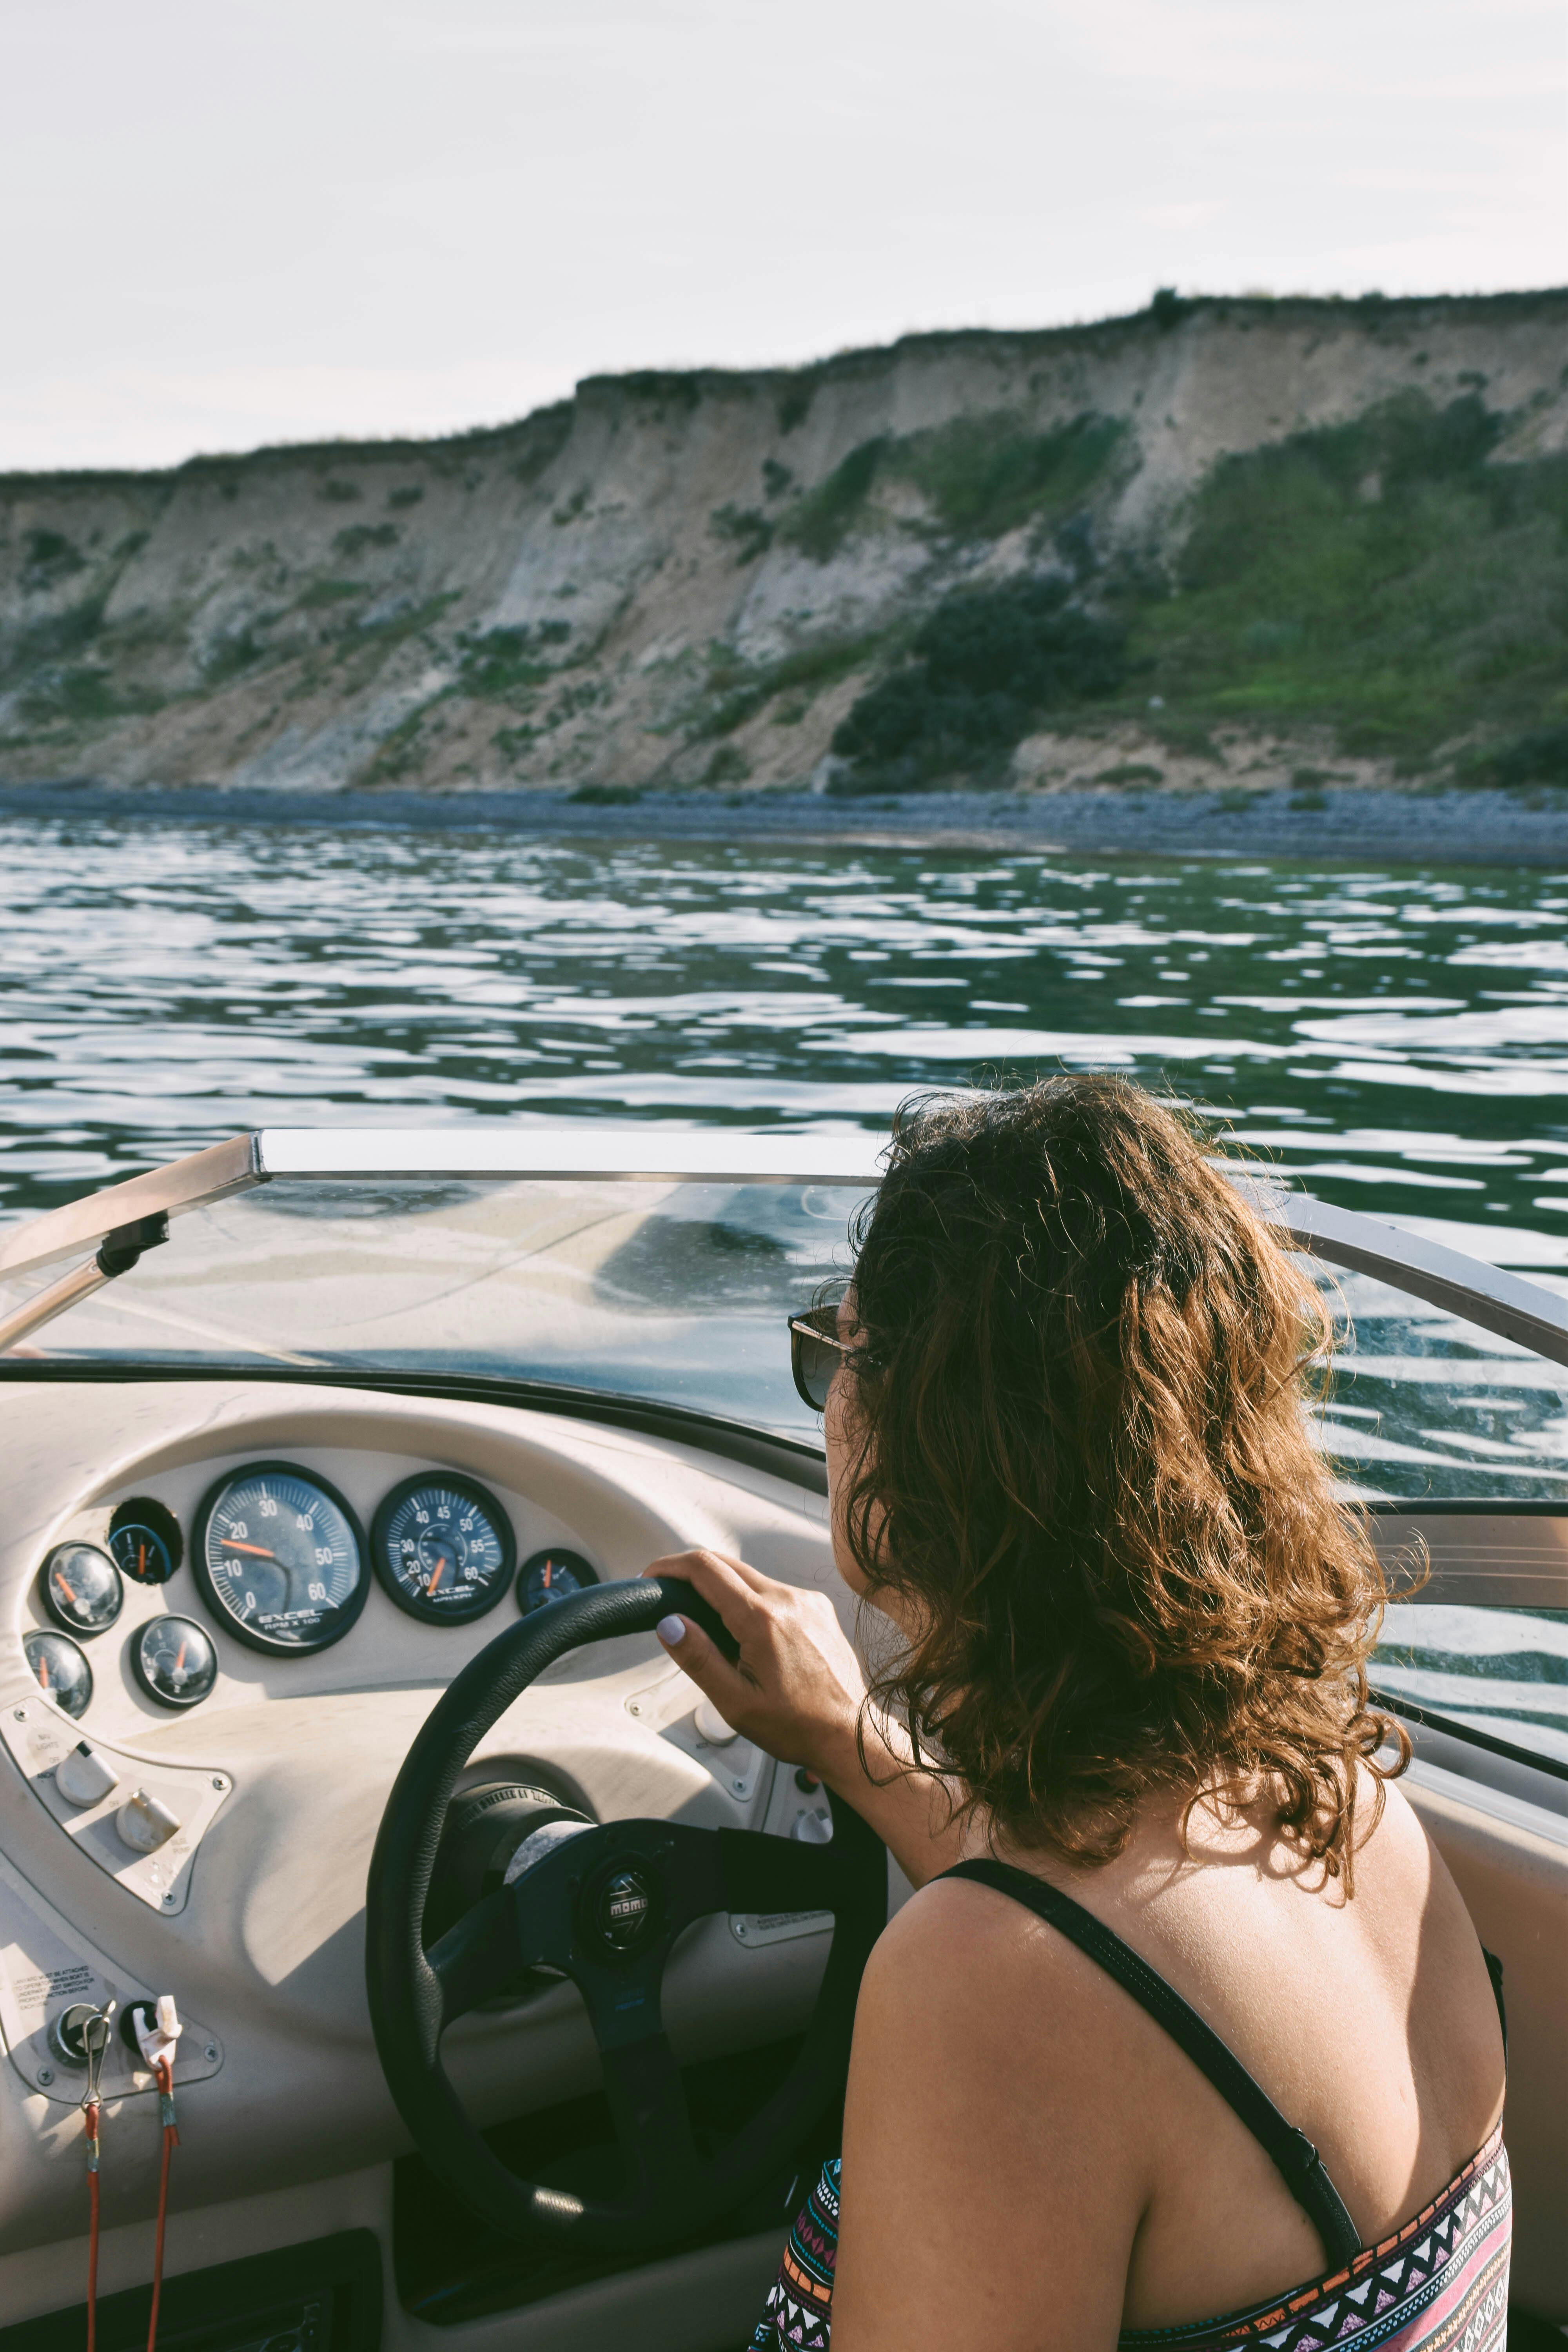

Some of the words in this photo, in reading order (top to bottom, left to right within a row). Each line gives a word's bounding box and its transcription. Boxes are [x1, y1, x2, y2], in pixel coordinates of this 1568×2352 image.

[259, 1500, 277, 1516] 30
[437, 1506, 450, 1519] 45
[296, 1514, 313, 1531] 40
[416, 1510, 429, 1524] 40
[229, 1522, 247, 1539] 20
[459, 1518, 473, 1532] 50
[400, 1539, 414, 1552] 30
[471, 1539, 485, 1553] 55
[315, 1548, 332, 1565] 50
[225, 1560, 242, 1577] 10
[407, 1561, 421, 1574] 20
[464, 1566, 478, 1581] 60
[417, 1573, 431, 1586] 10
[309, 1583, 326, 1600] 60
[246, 1592, 256, 1609] 0
[258, 1609, 323, 1624] EXCEL
[264, 1622, 289, 1630] RPM
[62, 1965, 88, 1975] ATTACHED
[62, 1980, 83, 1989] SWITCH
